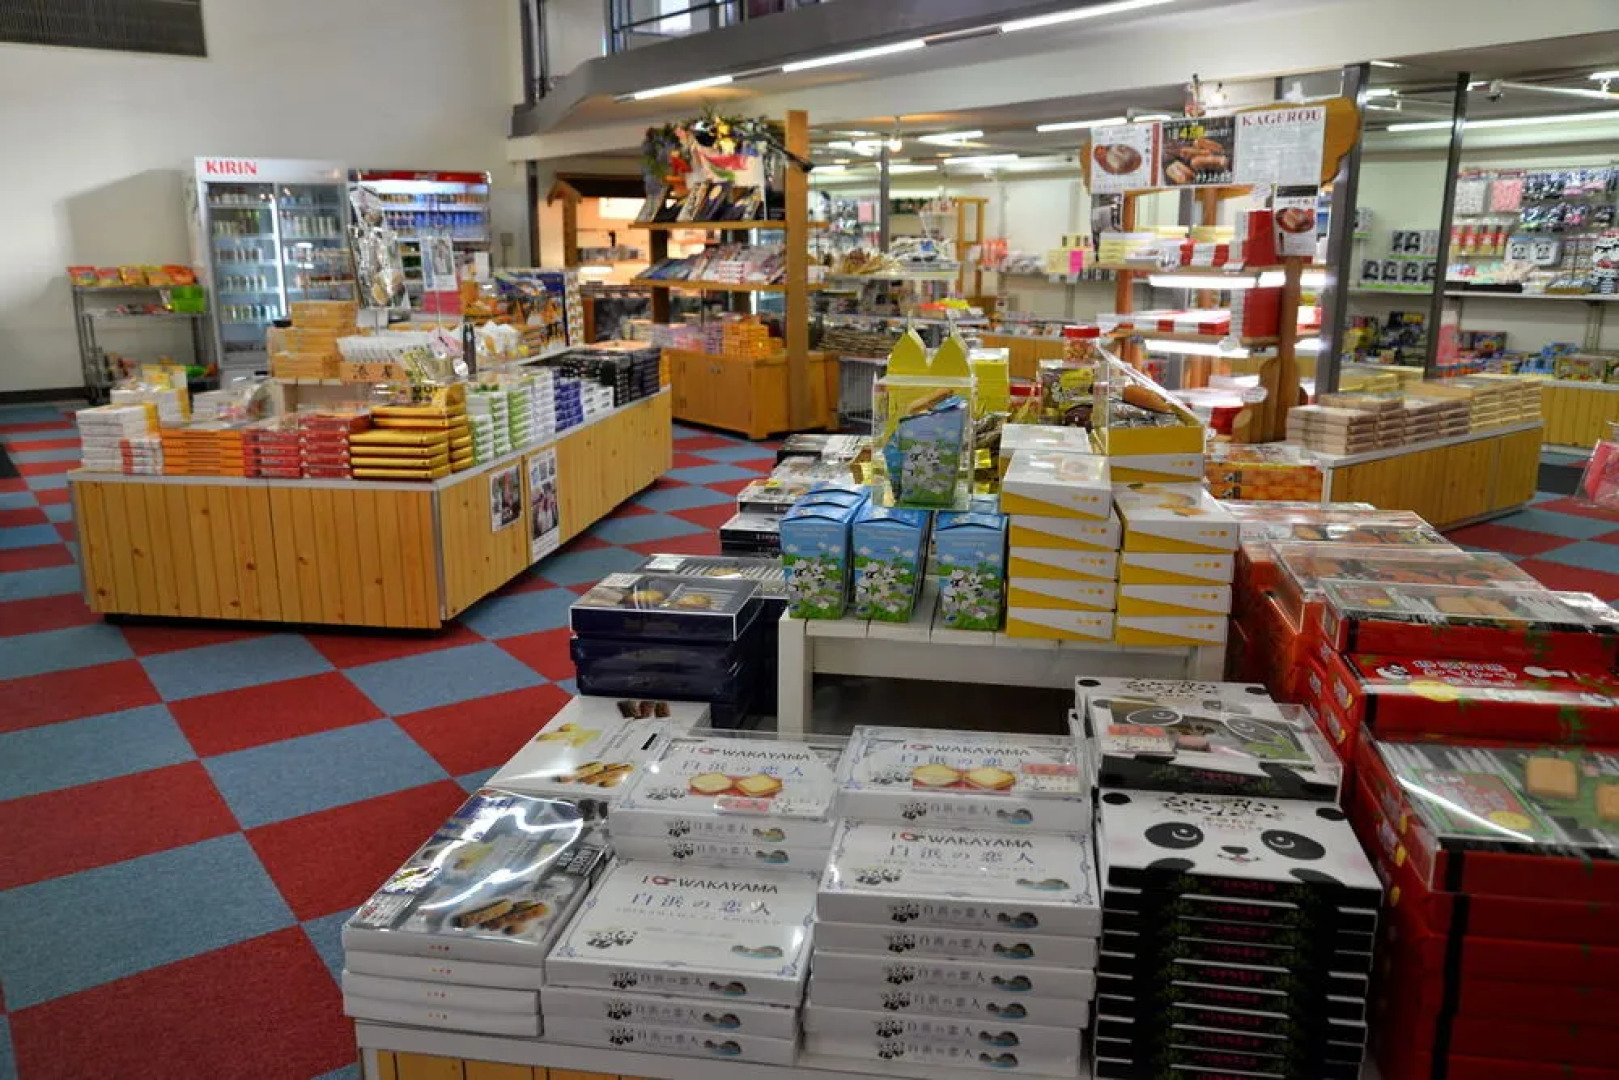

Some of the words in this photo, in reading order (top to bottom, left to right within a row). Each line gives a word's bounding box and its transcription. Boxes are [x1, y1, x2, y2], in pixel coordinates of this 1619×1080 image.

[1242, 109, 1321, 127] KAGEROU
[206, 160, 257, 175] KIRIN
[723, 748, 810, 761] WAKAYAMA
[935, 744, 1030, 757] WAKAYAMA
[929, 834, 1034, 849] WAKAYAMA
[679, 878, 778, 895] WAKAYAMA
